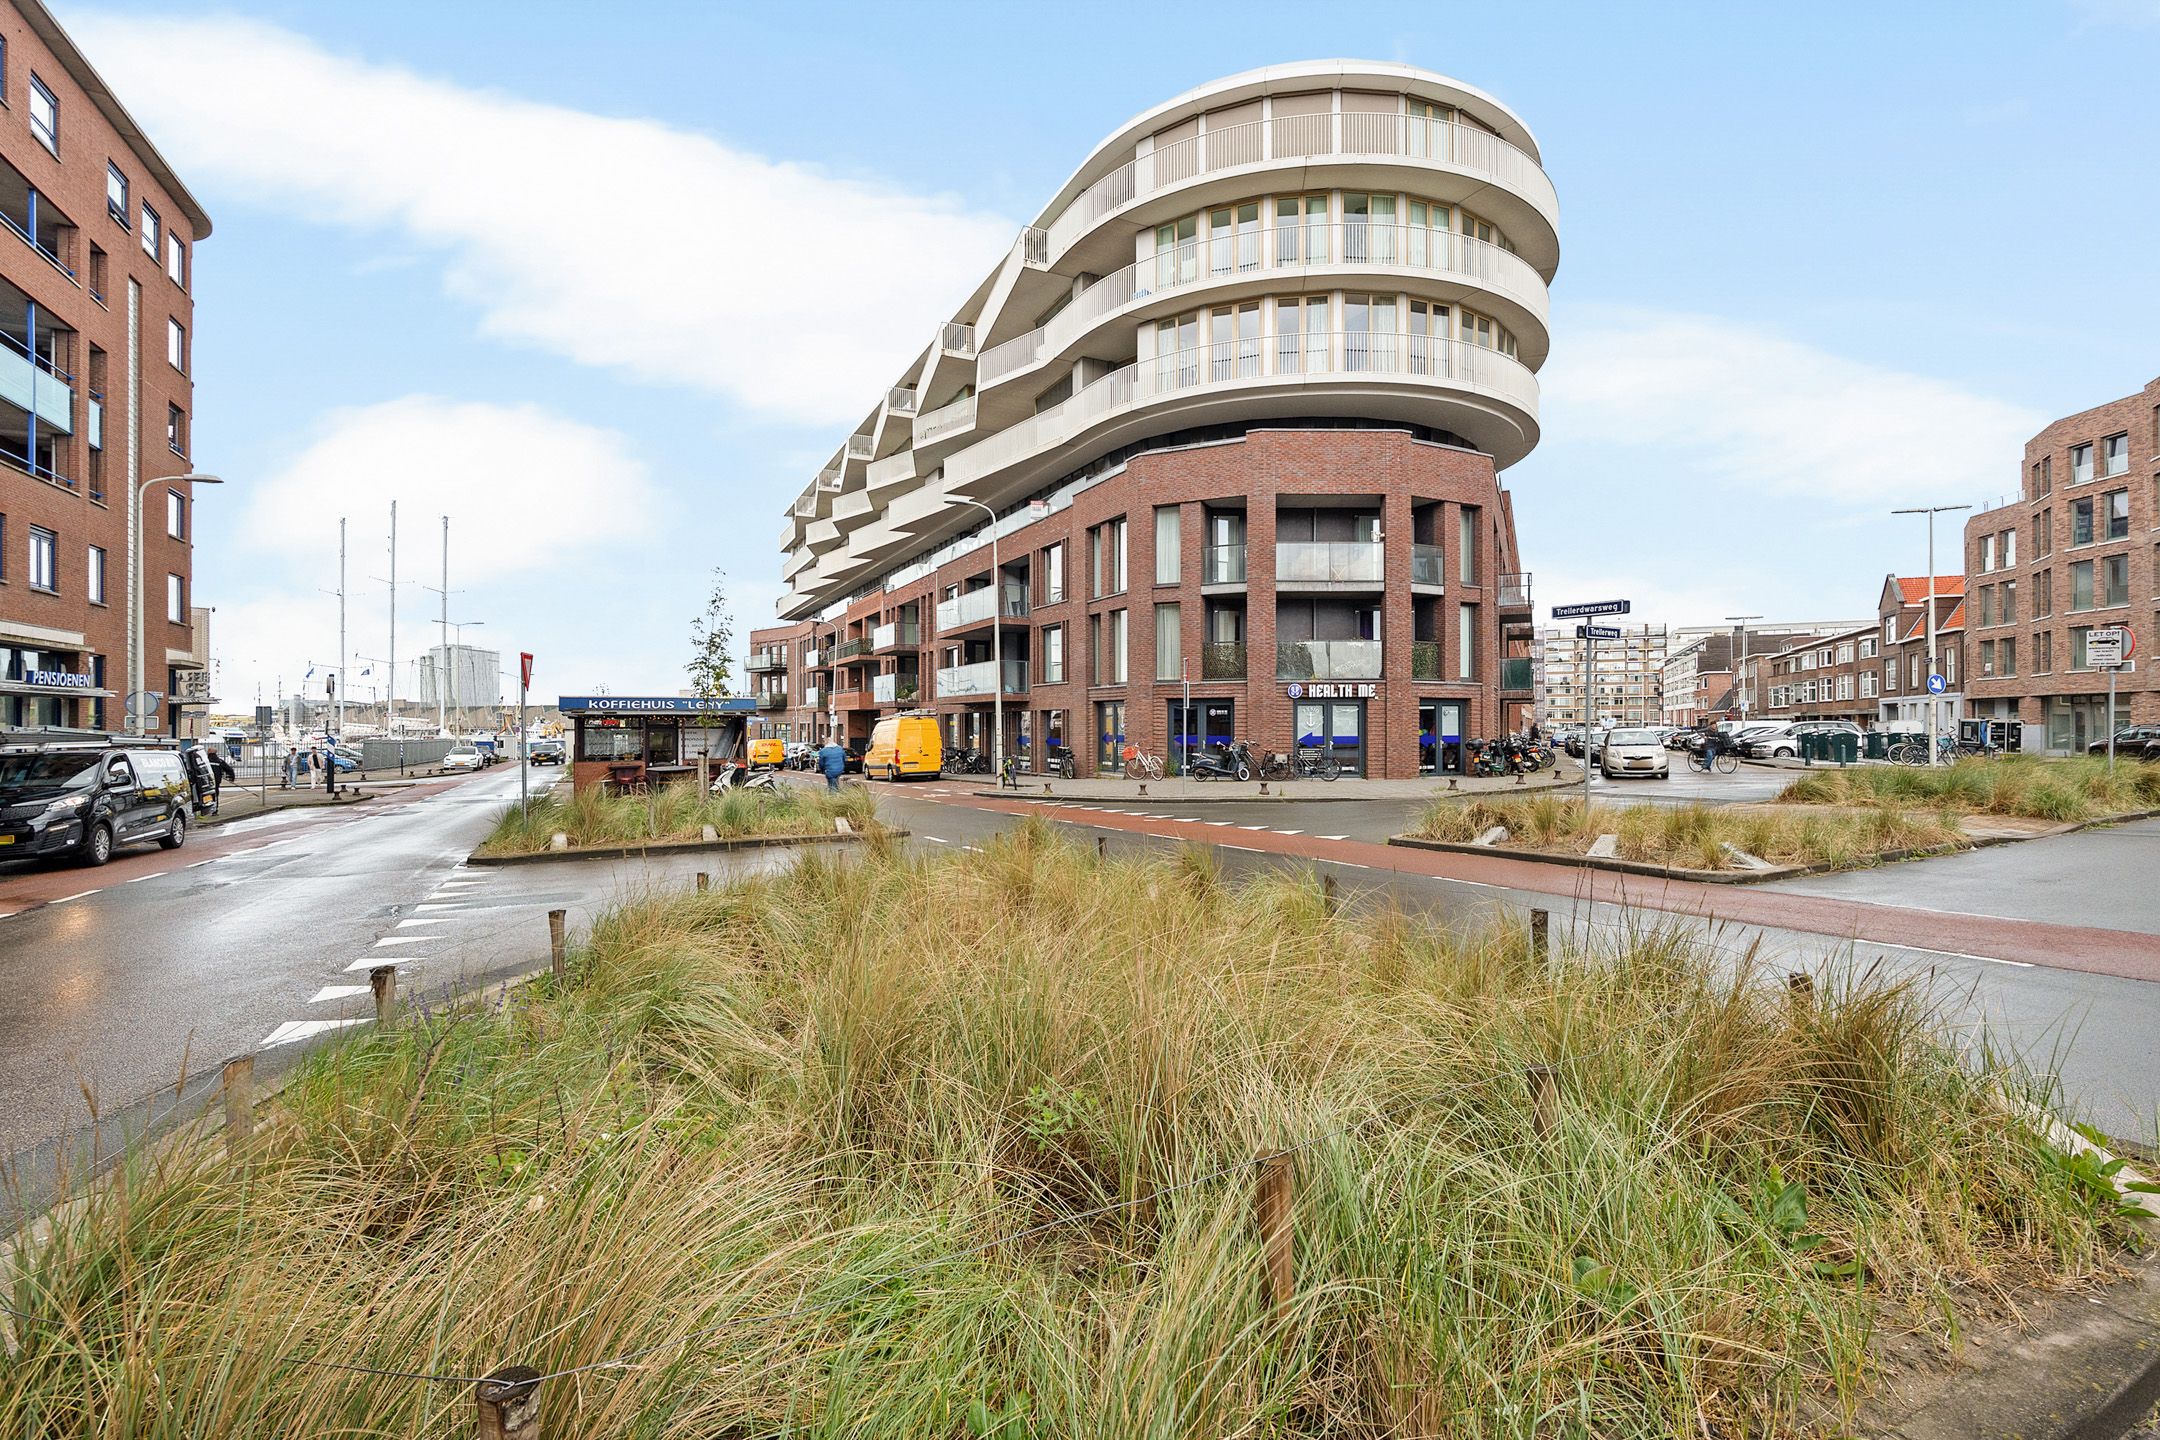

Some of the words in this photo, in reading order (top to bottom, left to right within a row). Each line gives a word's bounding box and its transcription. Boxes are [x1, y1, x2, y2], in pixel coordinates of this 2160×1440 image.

[33, 670, 90, 687] PENSIOENEN
[1308, 684, 1353, 698] HEALTH
[588, 700, 675, 709] KOFFIEHUIS
